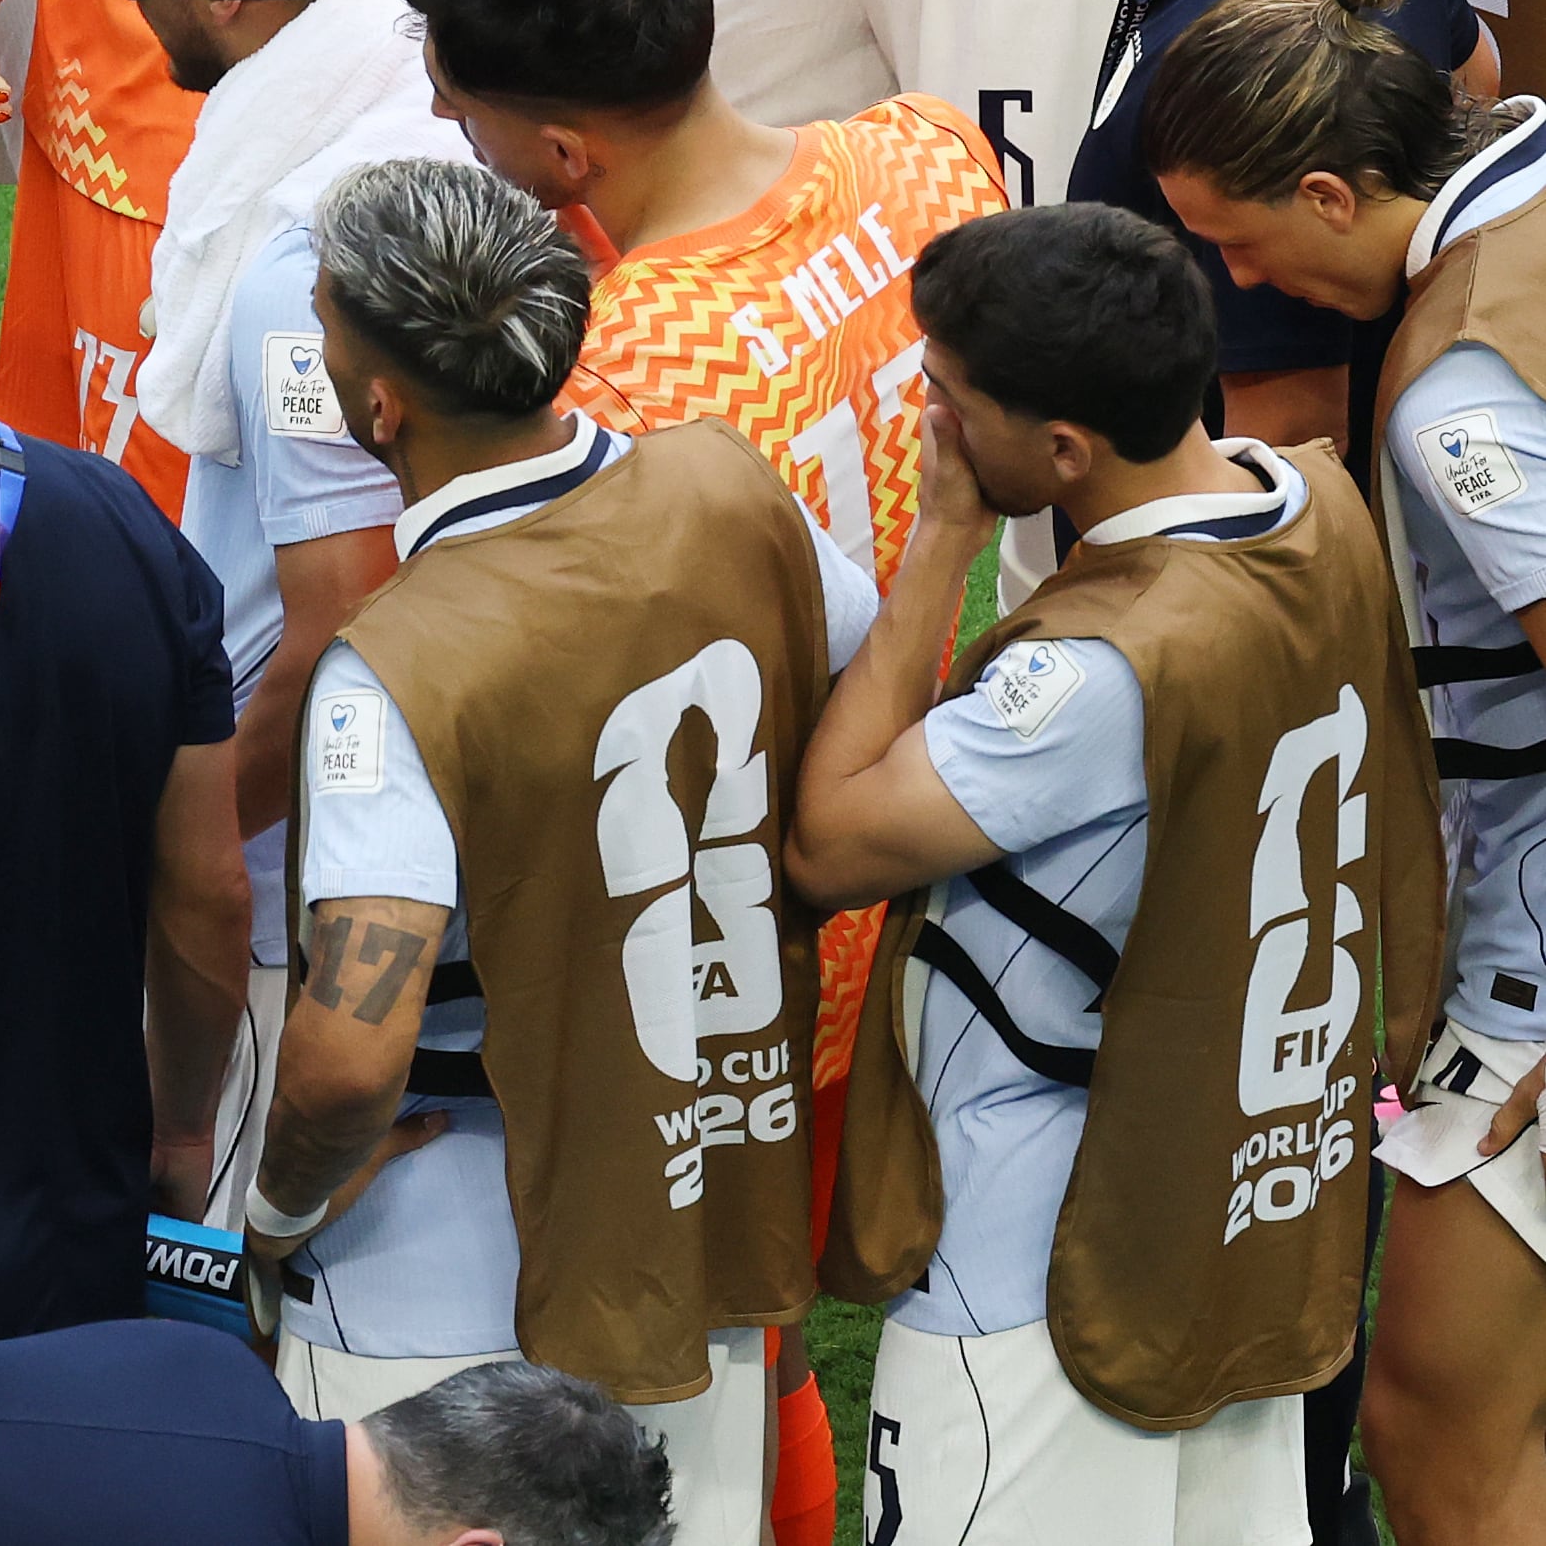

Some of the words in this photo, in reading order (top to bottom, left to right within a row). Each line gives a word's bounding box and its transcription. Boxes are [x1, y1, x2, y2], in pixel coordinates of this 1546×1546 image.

[730, 302, 803, 379] S.
[780, 202, 916, 341] MELE
[281, 378, 307, 394] Unite
[311, 380, 326, 395] For
[283, 397, 323, 414] PEACE
[290, 416, 311, 425] FIFA
[1445, 460, 1472, 481] Unite
[1454, 468, 1496, 497] PEACE
[1470, 490, 1492, 503] FIFA
[323, 754, 357, 771] PEACE
[327, 773, 346, 782] FIFA
[311, 917, 428, 1026] 17
